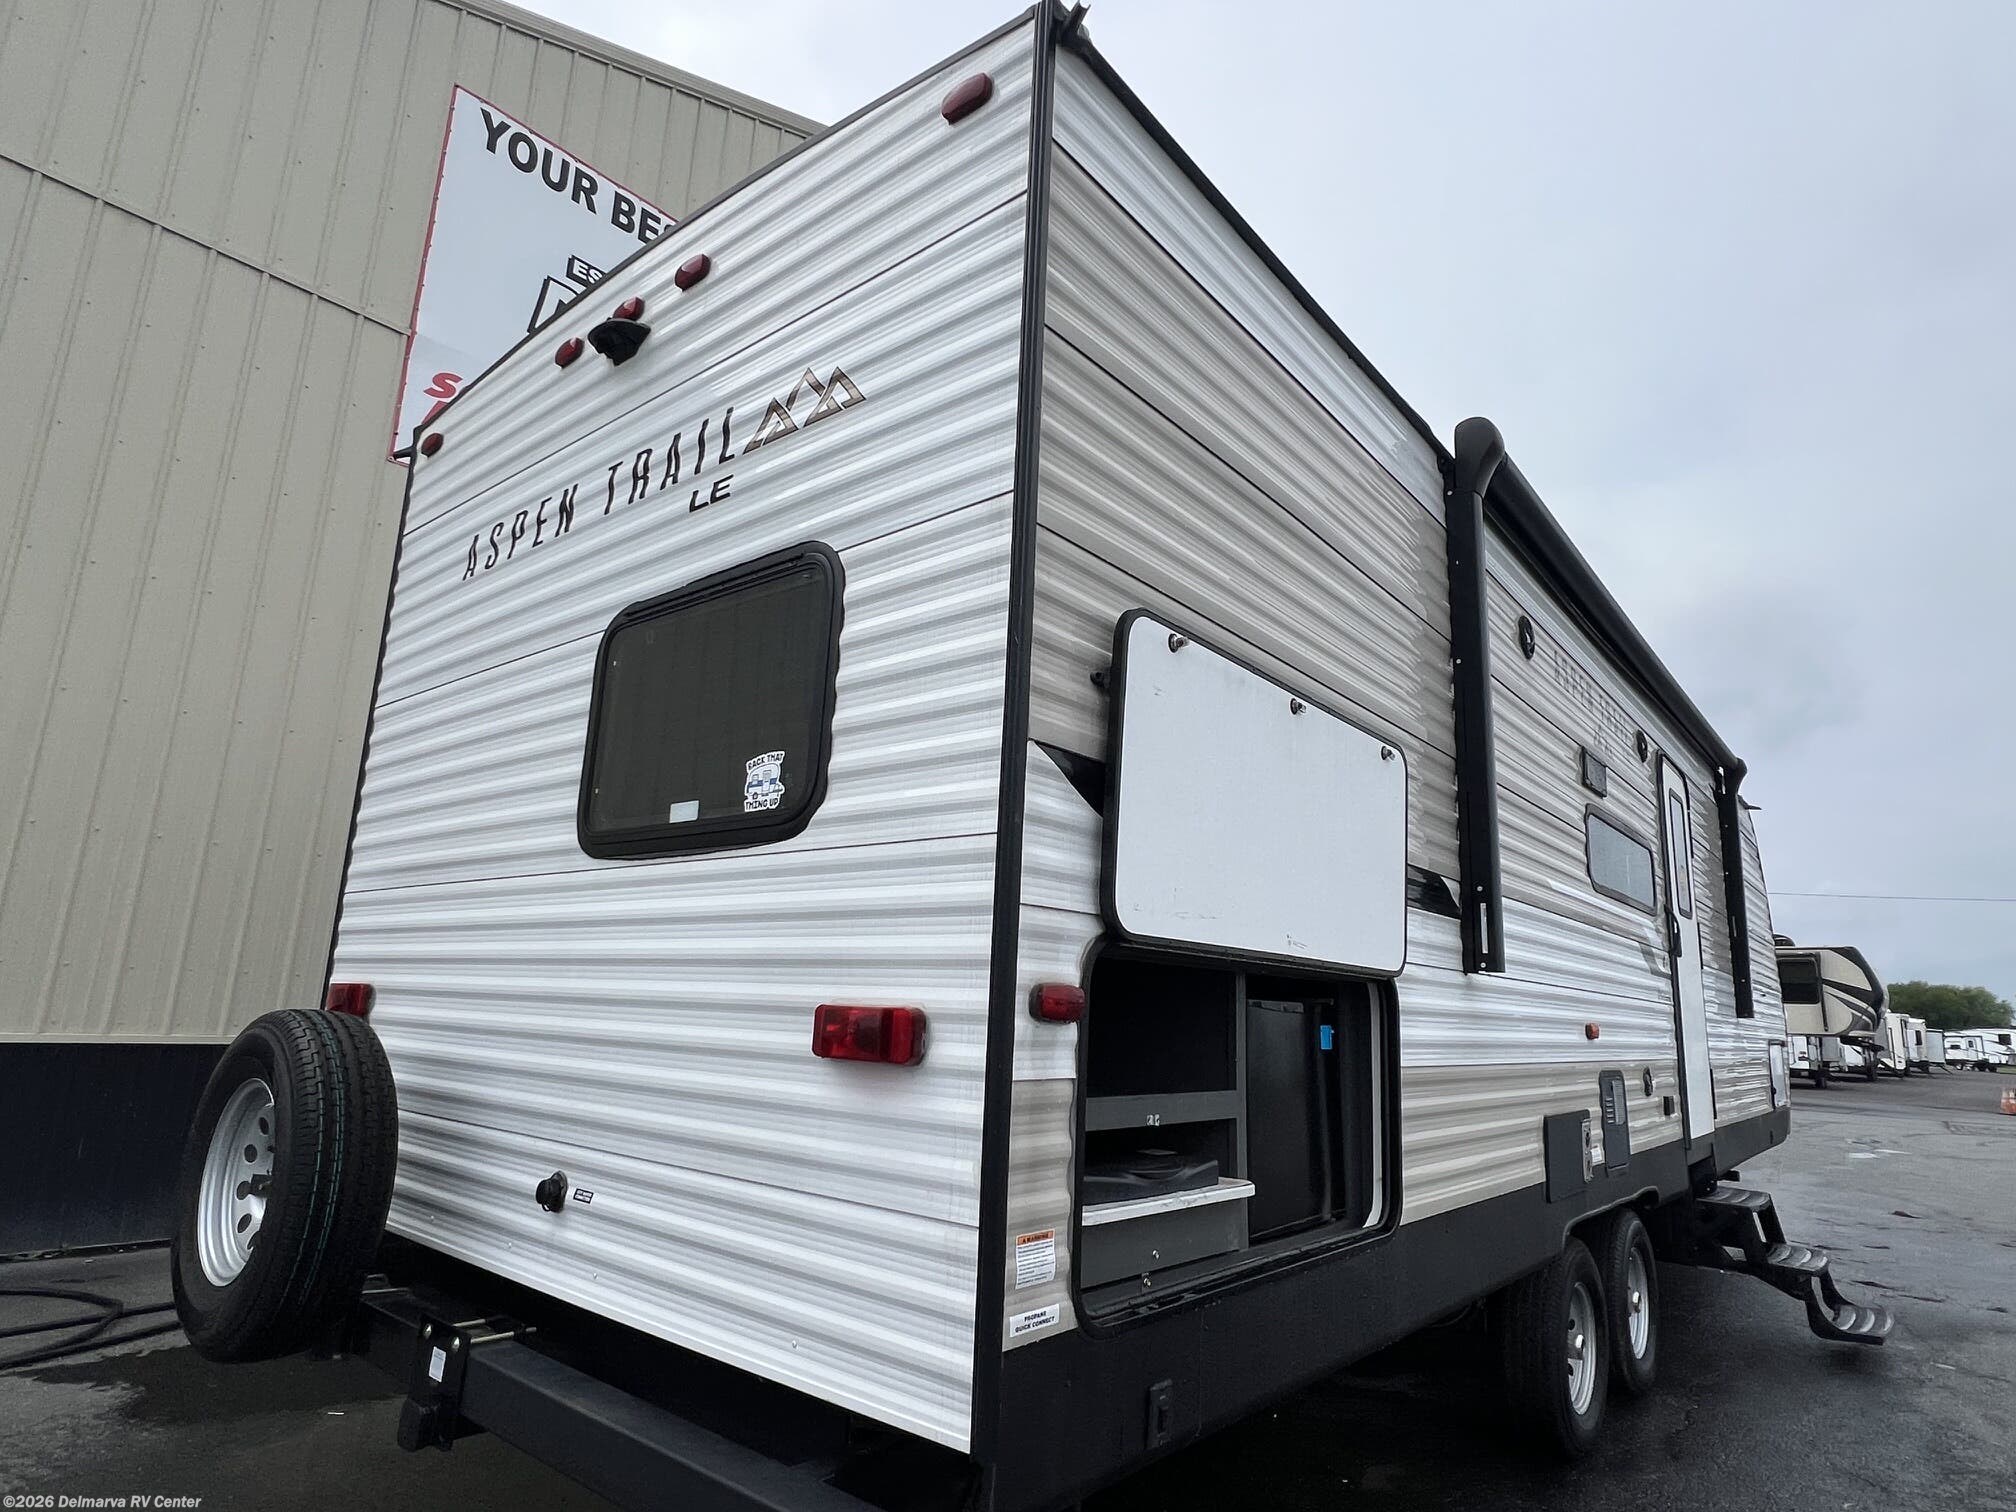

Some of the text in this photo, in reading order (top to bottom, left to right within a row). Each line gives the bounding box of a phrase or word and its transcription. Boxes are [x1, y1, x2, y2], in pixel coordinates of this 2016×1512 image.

[480, 107, 672, 244] YOUR BE
[462, 406, 735, 581] ASPEN TRAIL
[689, 474, 735, 513] LE
[767, 753, 783, 762] THAT
[745, 797, 779, 810] THING UP
[1015, 1316, 1055, 1333] QUICK CONNECT
[1024, 1310, 1047, 1322] PROPANE
